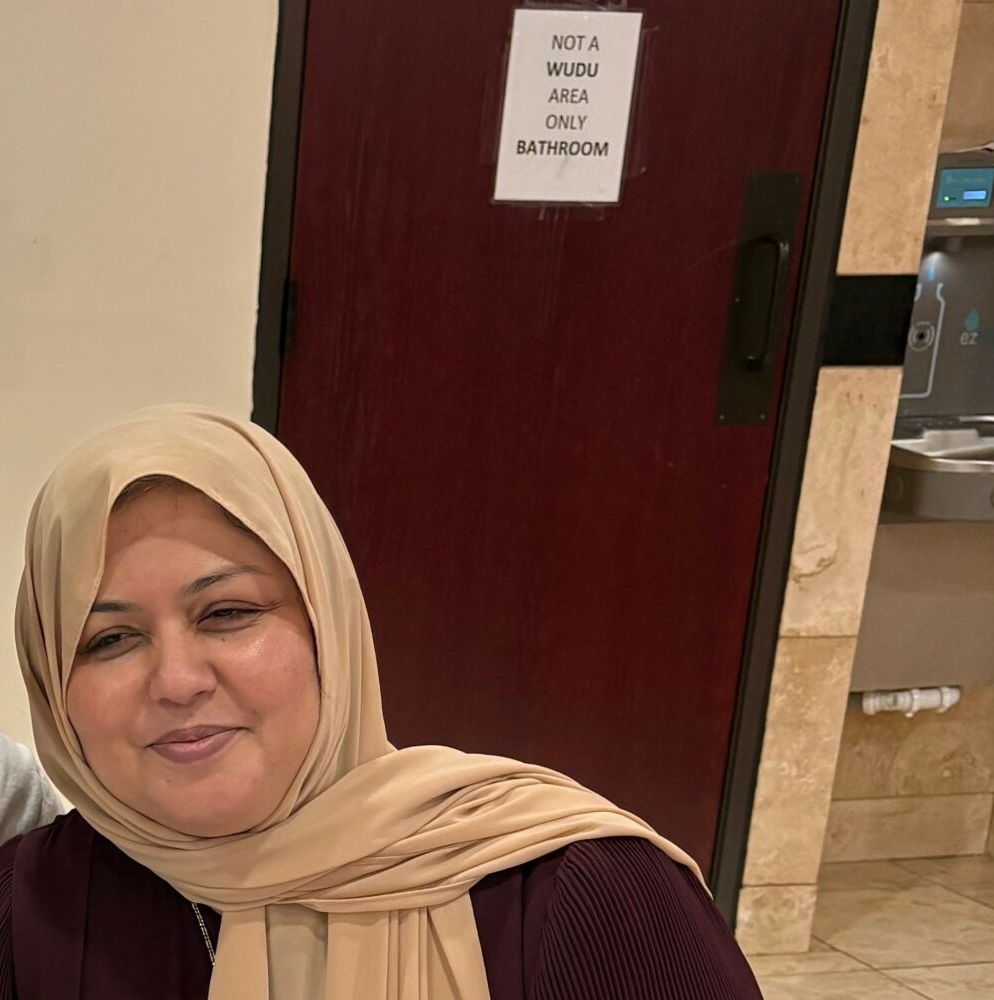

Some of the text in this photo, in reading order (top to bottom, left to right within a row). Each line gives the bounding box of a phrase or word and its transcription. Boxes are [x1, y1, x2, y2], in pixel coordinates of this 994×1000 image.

[552, 35, 600, 51] NOT A
[546, 62, 599, 77] WUDU
[548, 88, 589, 104] AREA
[545, 115, 587, 130] ONLY
[516, 140, 609, 156] BATHROOM
